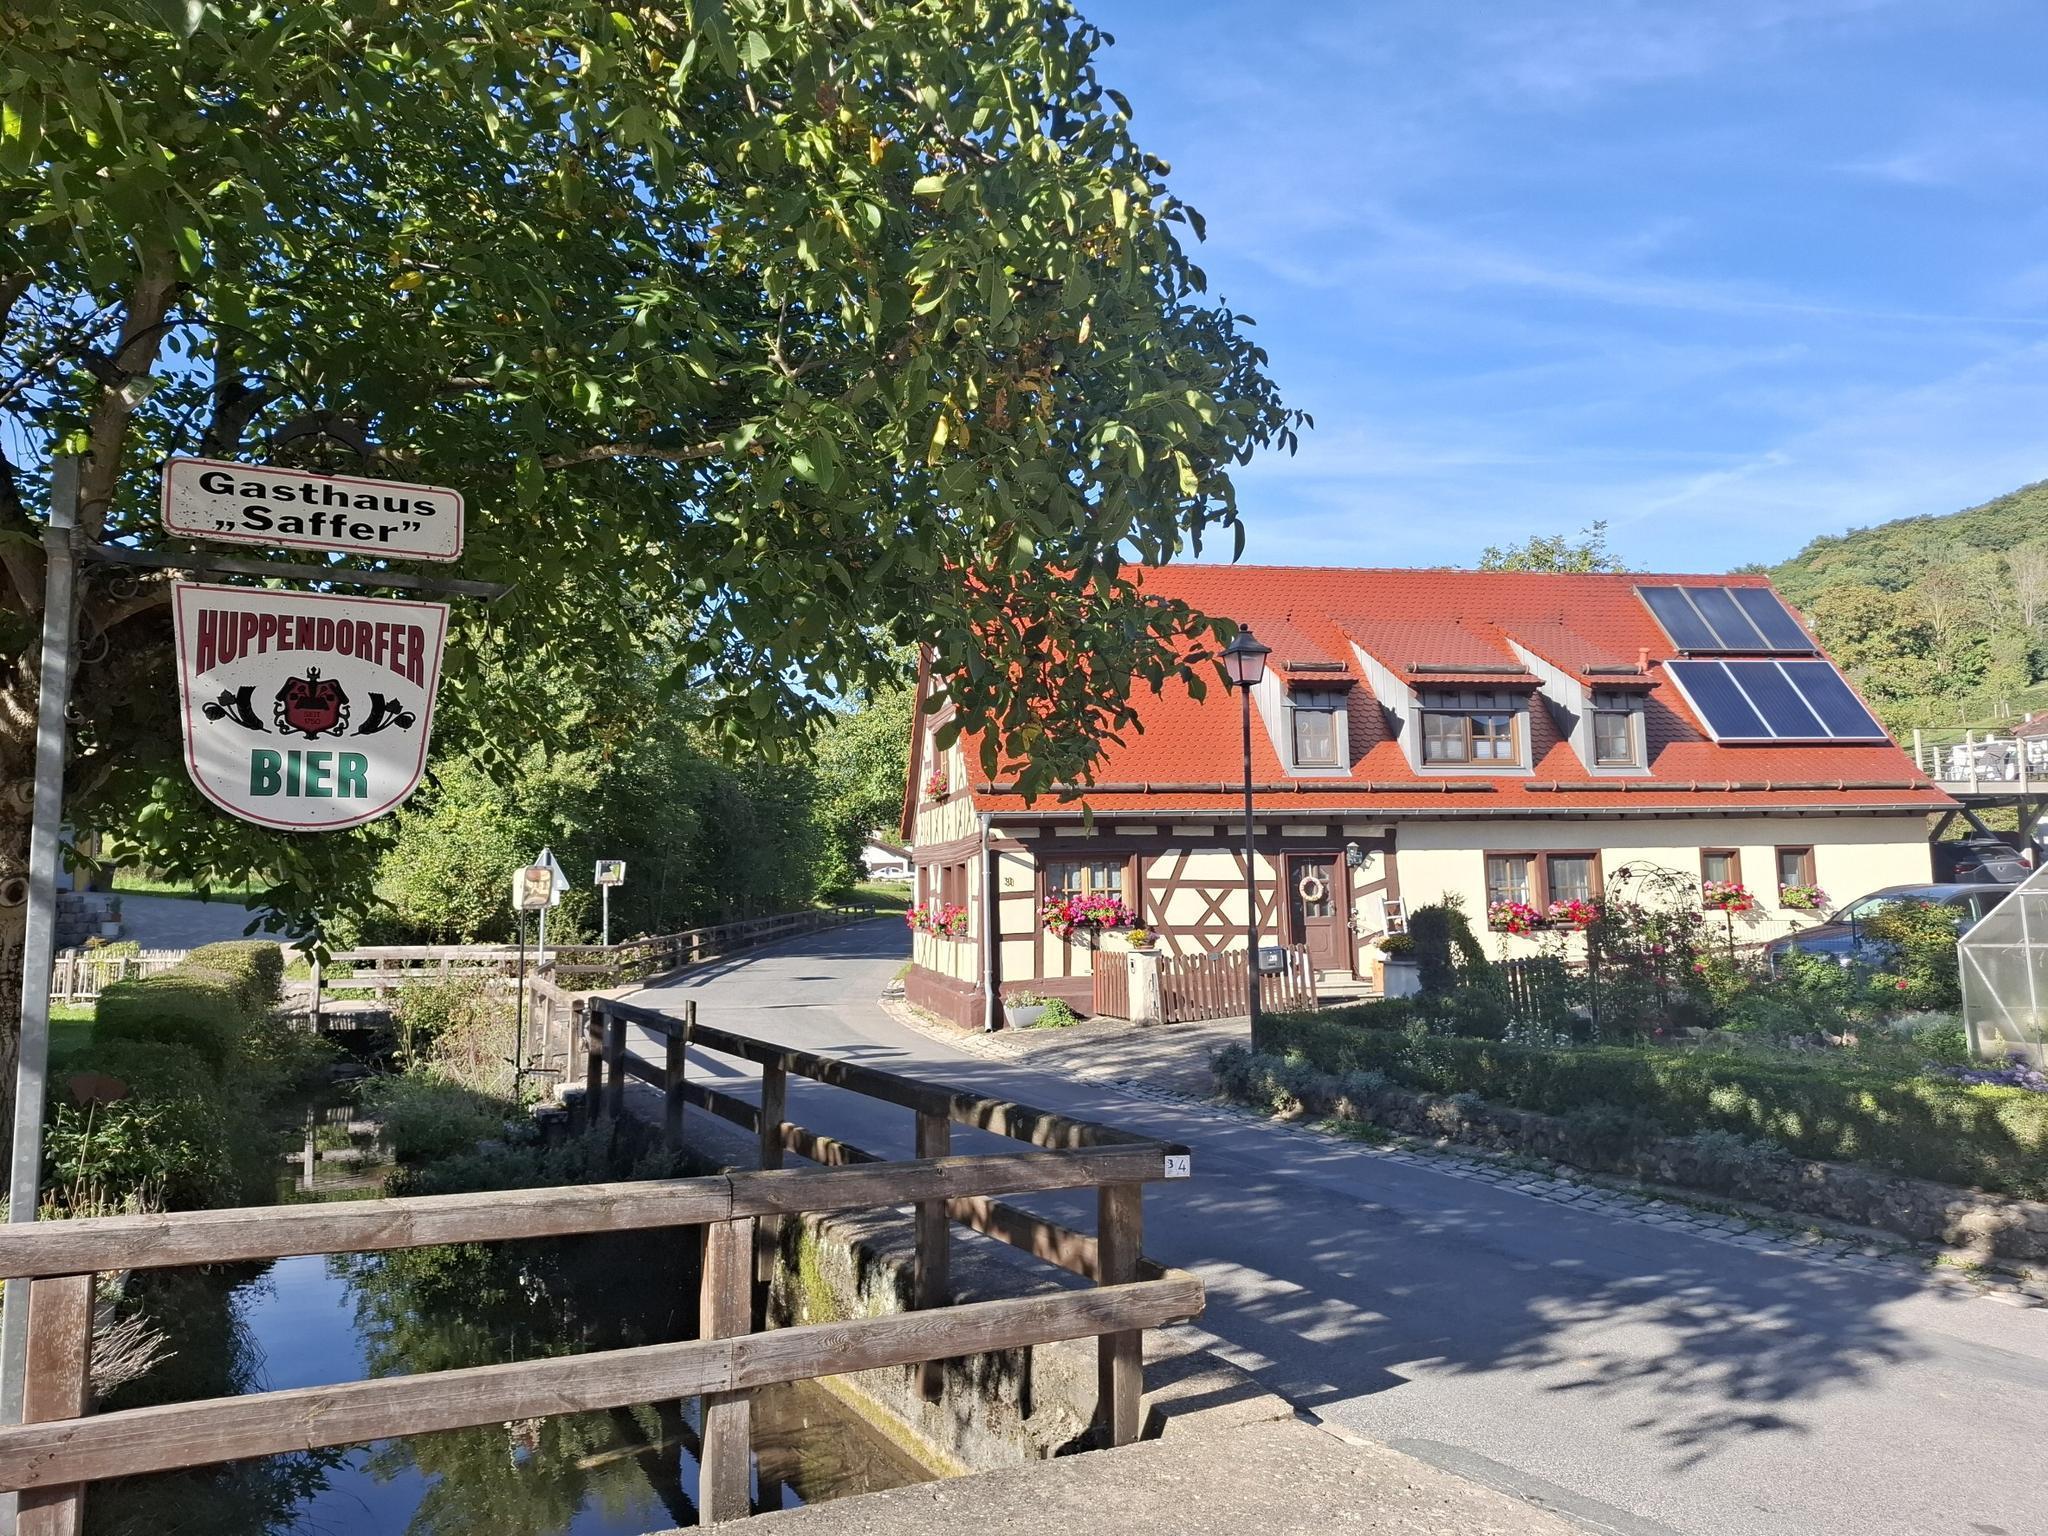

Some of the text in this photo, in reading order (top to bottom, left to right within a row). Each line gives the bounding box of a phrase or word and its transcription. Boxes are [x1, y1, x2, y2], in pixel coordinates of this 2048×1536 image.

[199, 471, 437, 516] Gasthaus
[196, 609, 425, 689] HUPPENDORFER
[250, 749, 368, 798] BIER
